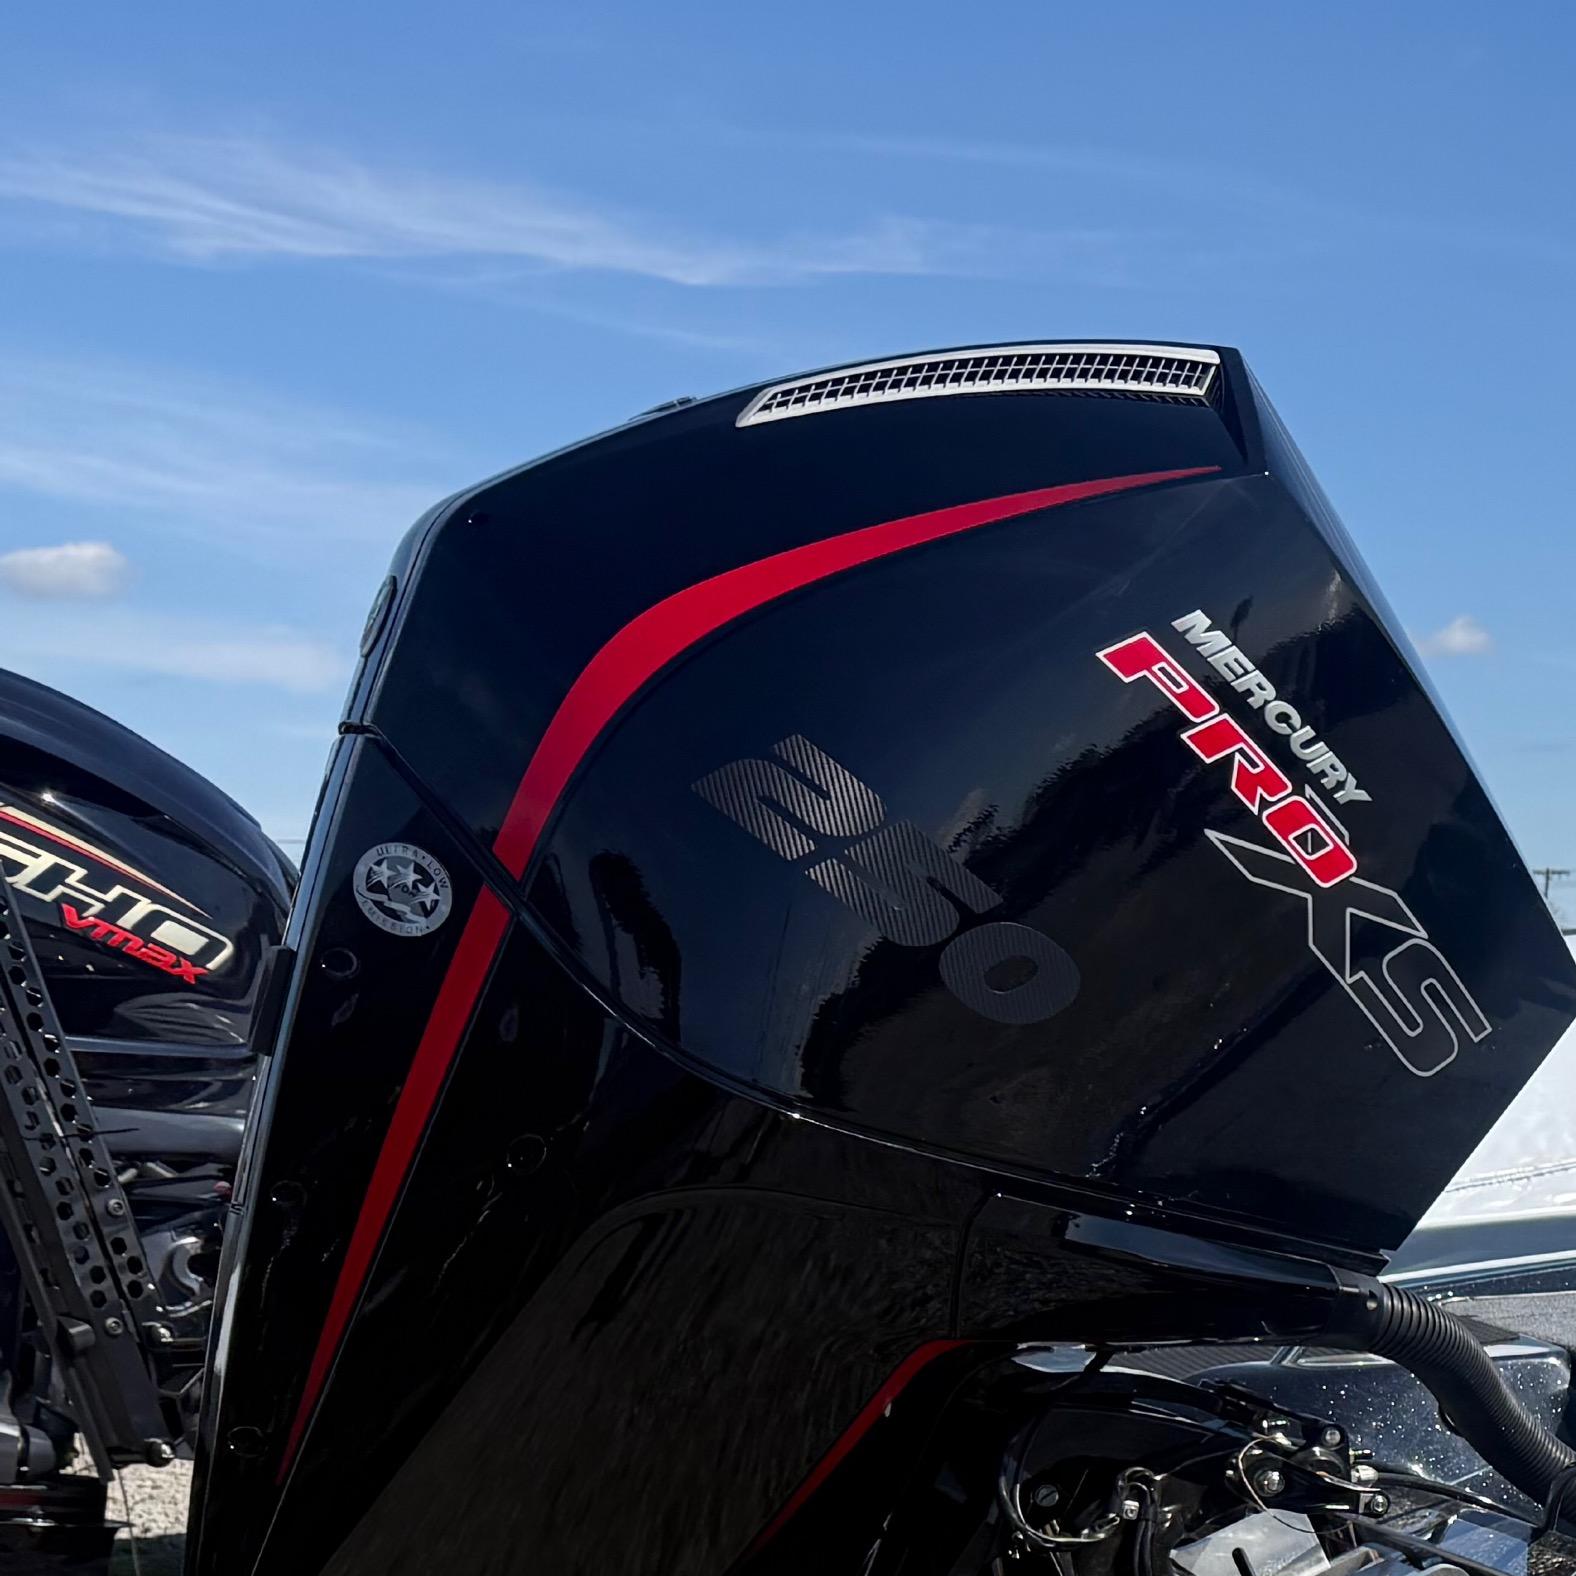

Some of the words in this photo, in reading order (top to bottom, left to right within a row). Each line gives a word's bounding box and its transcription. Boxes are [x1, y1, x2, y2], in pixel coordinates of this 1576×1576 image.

[1095, 631, 1359, 889] PRO
[1171, 609, 1373, 804] MERCURY
[375, 844, 420, 859] ULTRA
[426, 860, 449, 890] LOW
[690, 733, 1082, 1025] 250
[1203, 784, 1492, 1078] XS
